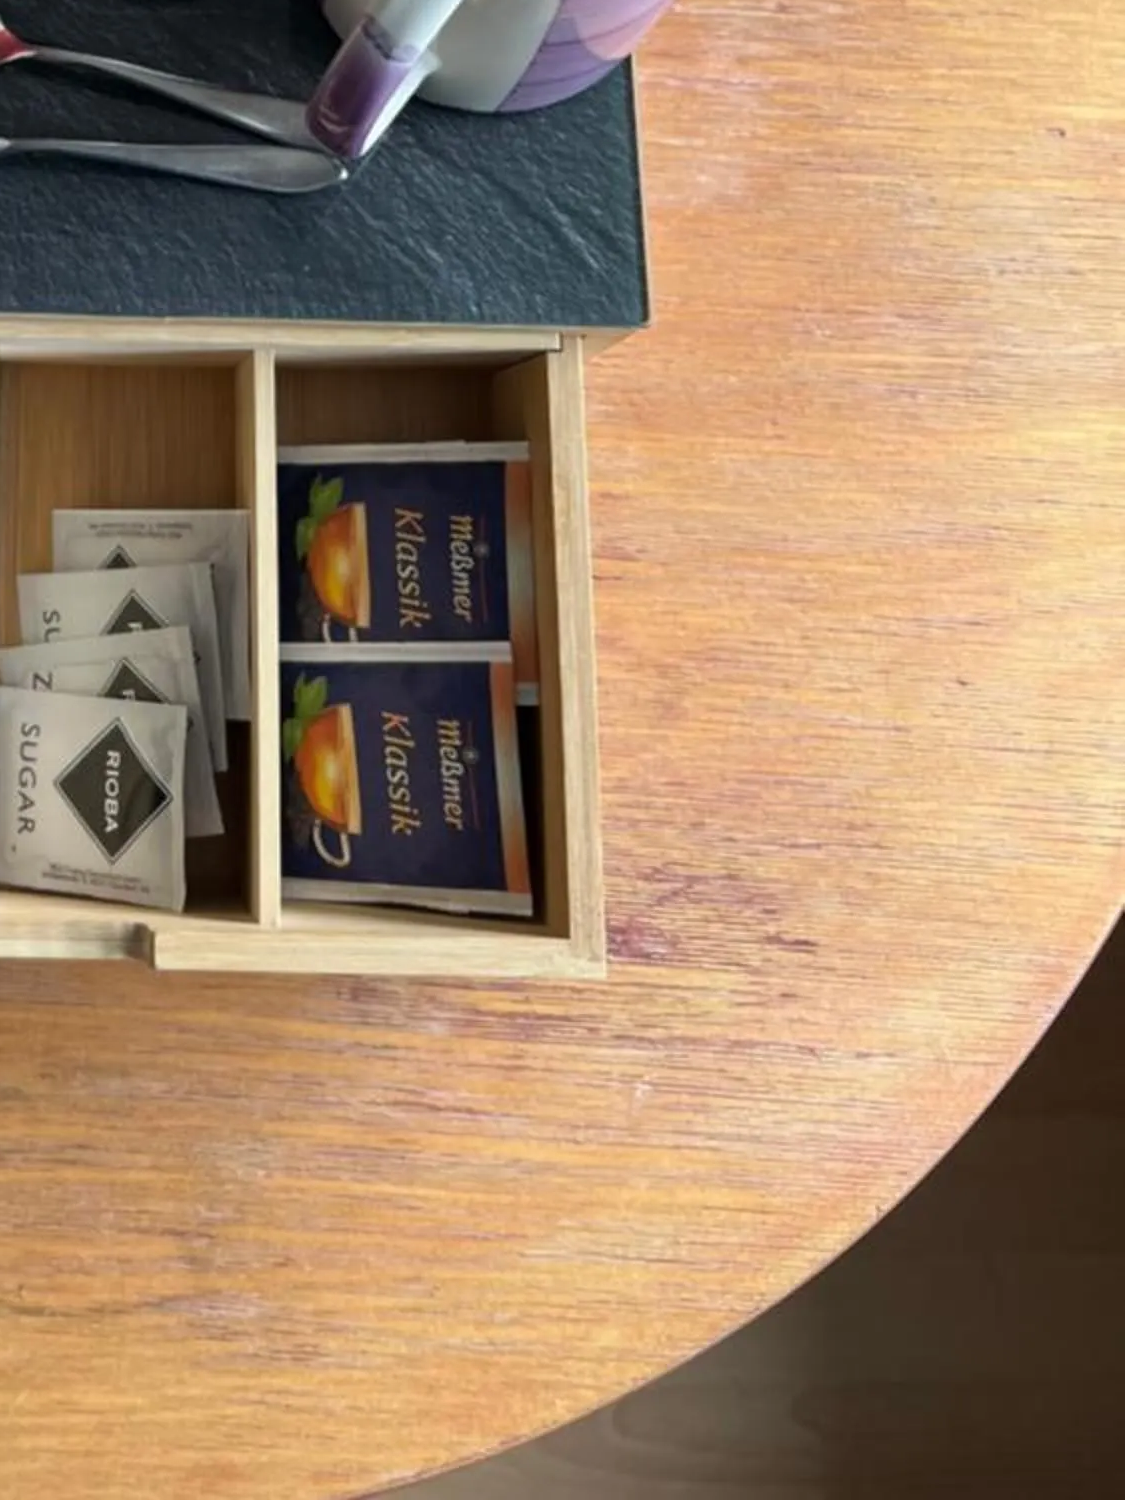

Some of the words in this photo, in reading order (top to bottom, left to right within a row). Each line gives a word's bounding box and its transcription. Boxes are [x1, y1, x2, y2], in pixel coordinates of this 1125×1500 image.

[394, 507, 432, 629] Klassik
[16, 721, 41, 835] SUGAR
[103, 749, 123, 835] RIOBA
[381, 710, 422, 836] Klassik
